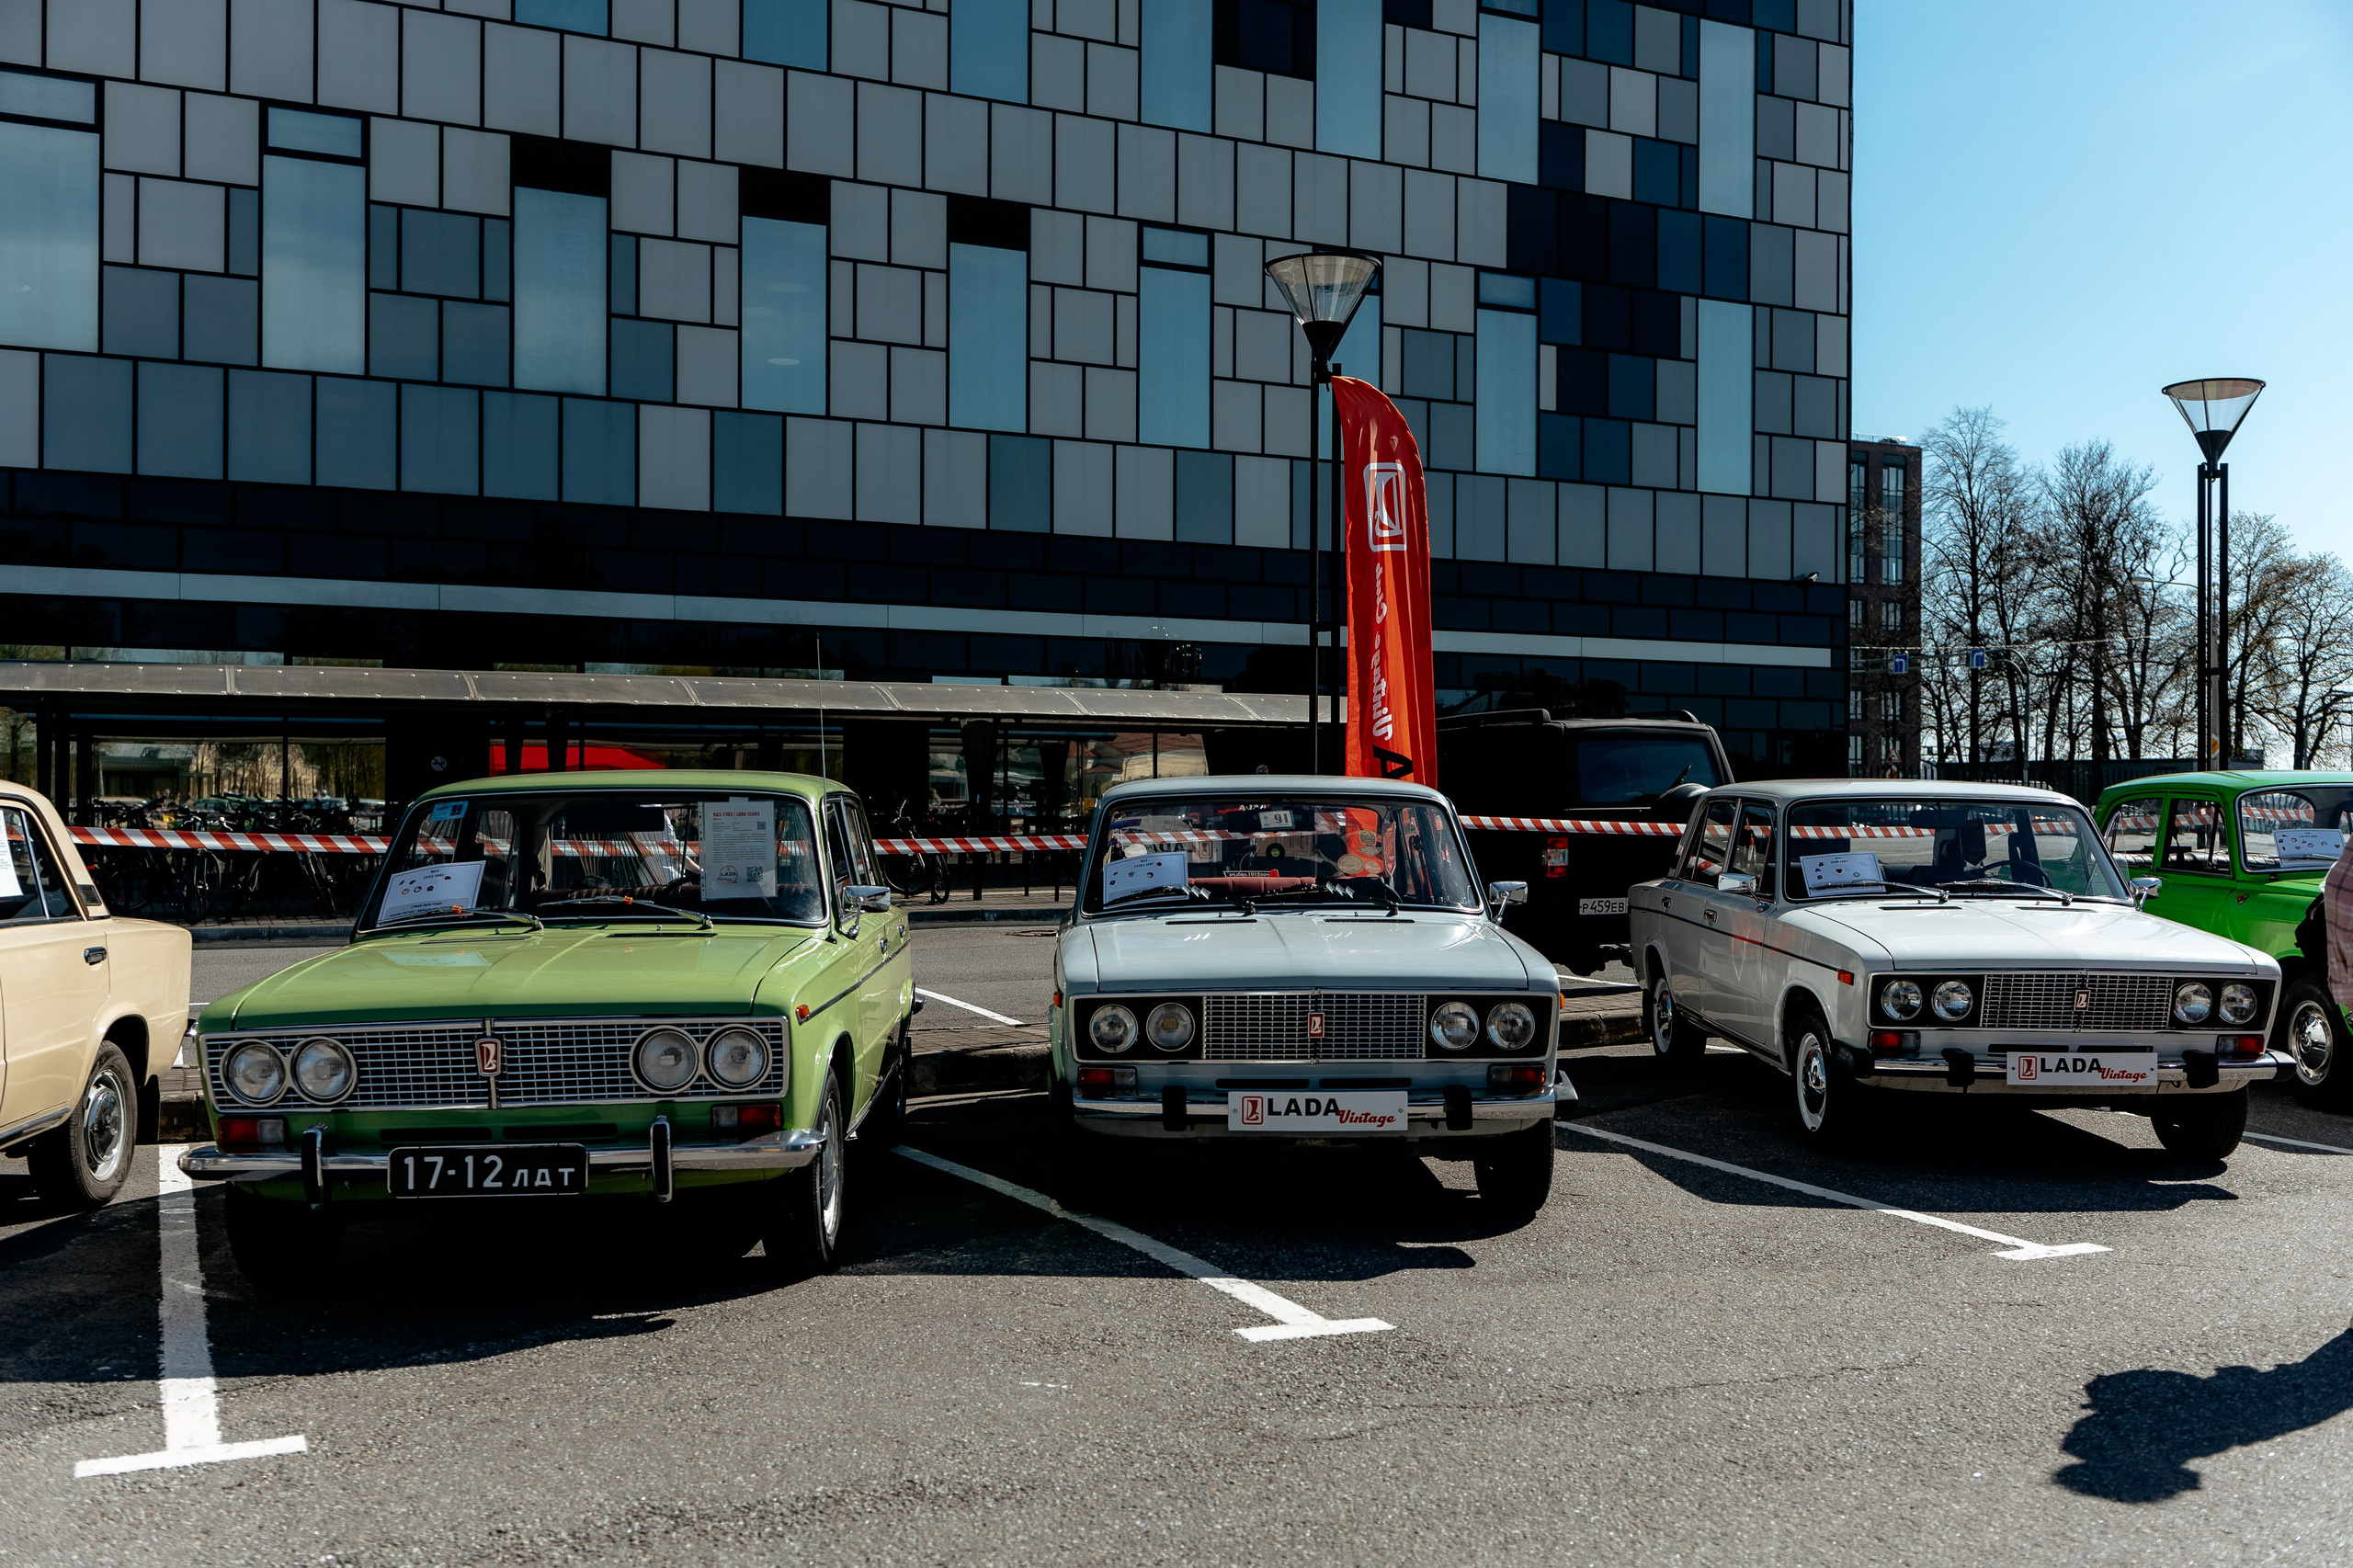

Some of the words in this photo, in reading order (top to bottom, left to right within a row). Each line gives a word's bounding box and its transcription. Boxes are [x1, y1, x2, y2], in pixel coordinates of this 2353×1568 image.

[1274, 812, 1289, 824] 91
[2040, 1057, 2103, 1074] LADA
[2098, 1067, 2149, 1083] Vintage
[1267, 1097, 1340, 1117] LADA
[1336, 1109, 1397, 1128] Vintage
[404, 1154, 504, 1190] 17-12
[512, 1167, 575, 1187] ЛДТ
